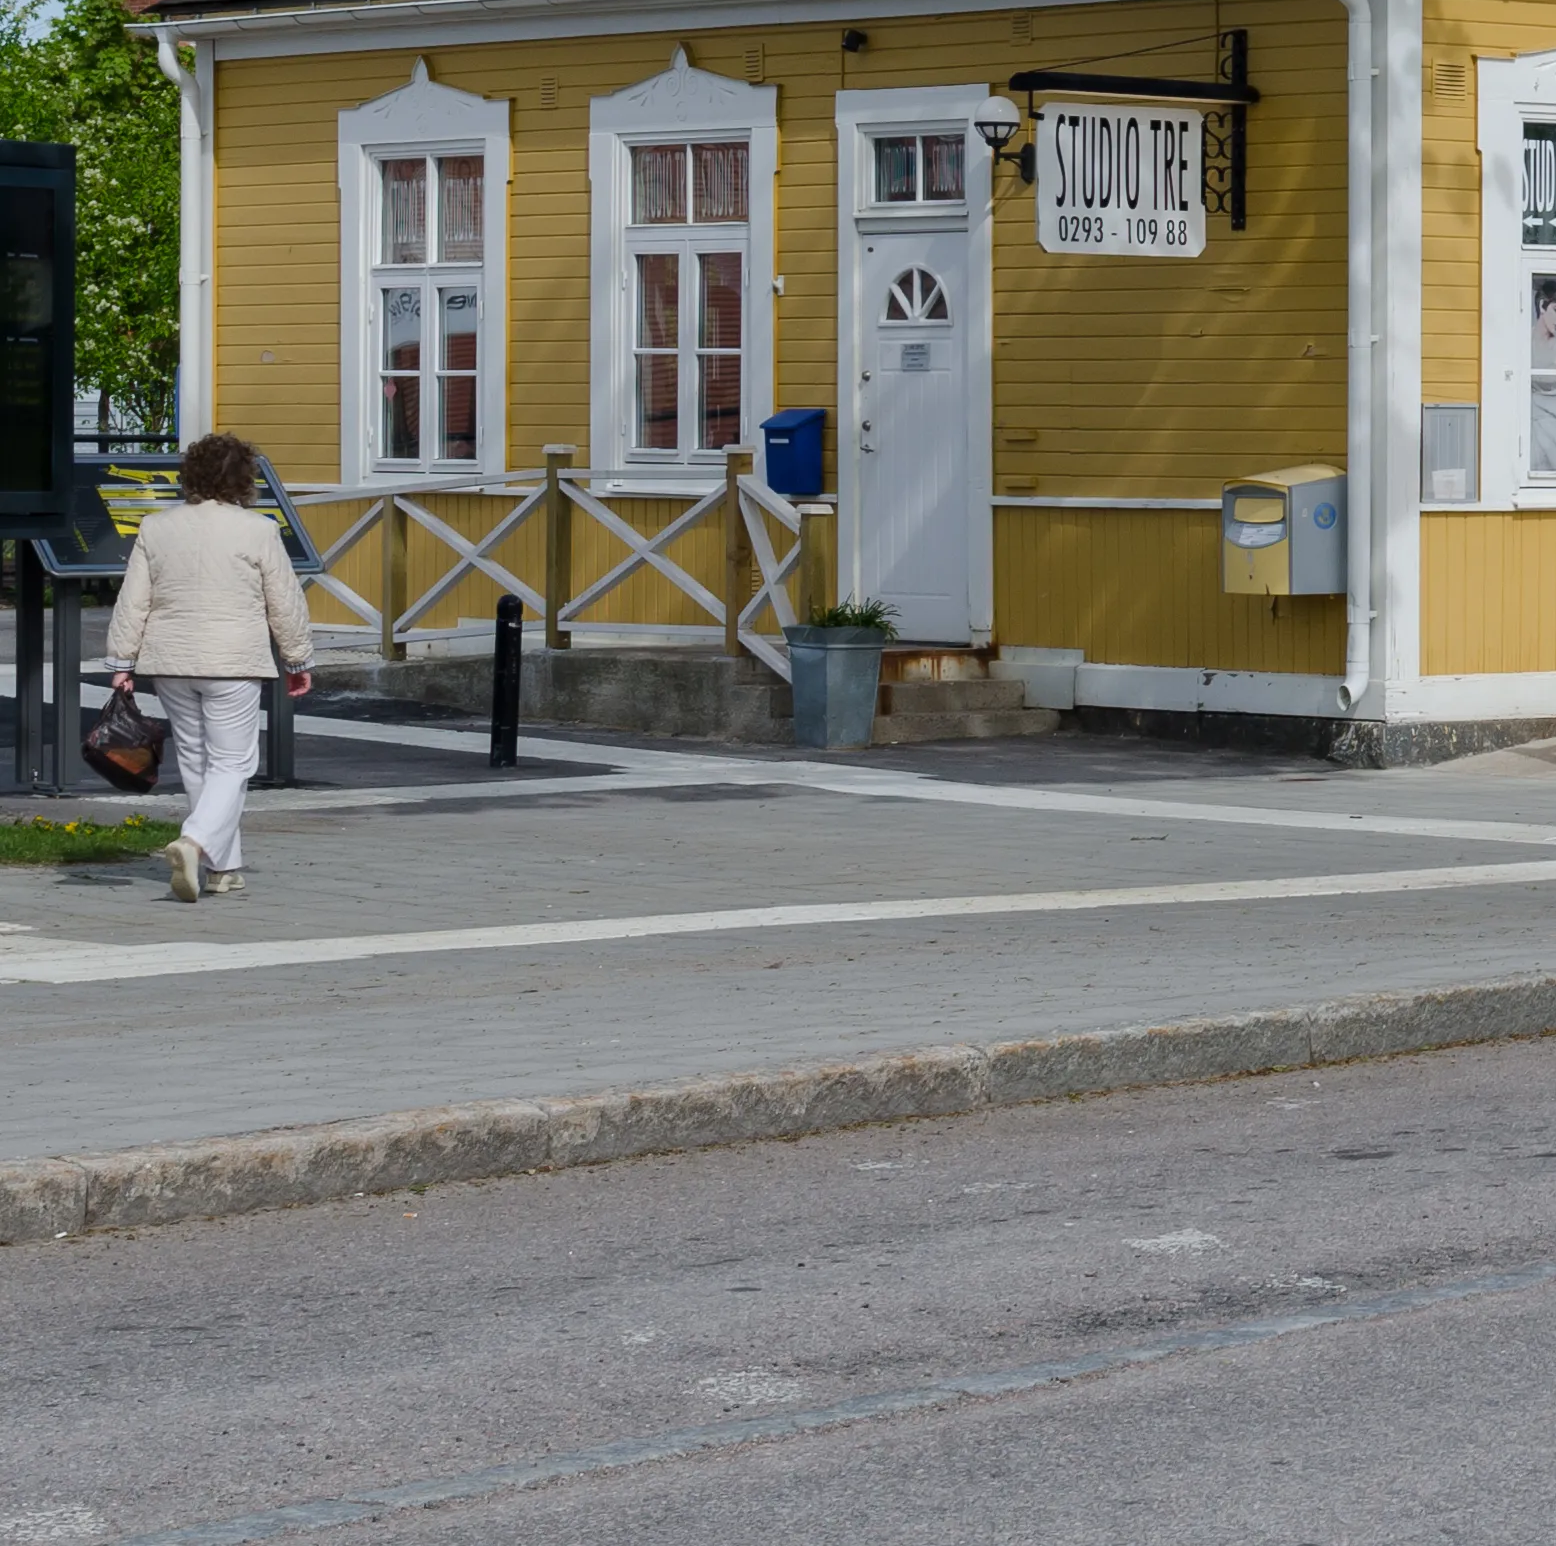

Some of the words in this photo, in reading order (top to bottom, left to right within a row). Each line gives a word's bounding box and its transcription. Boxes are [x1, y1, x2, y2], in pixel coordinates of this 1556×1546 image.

[1056, 113, 1140, 209] STUDIO
[1150, 119, 1189, 211] TRE
[1058, 215, 1104, 243] 0293
[1126, 218, 1158, 245] 109
[1166, 220, 1187, 246] 88
